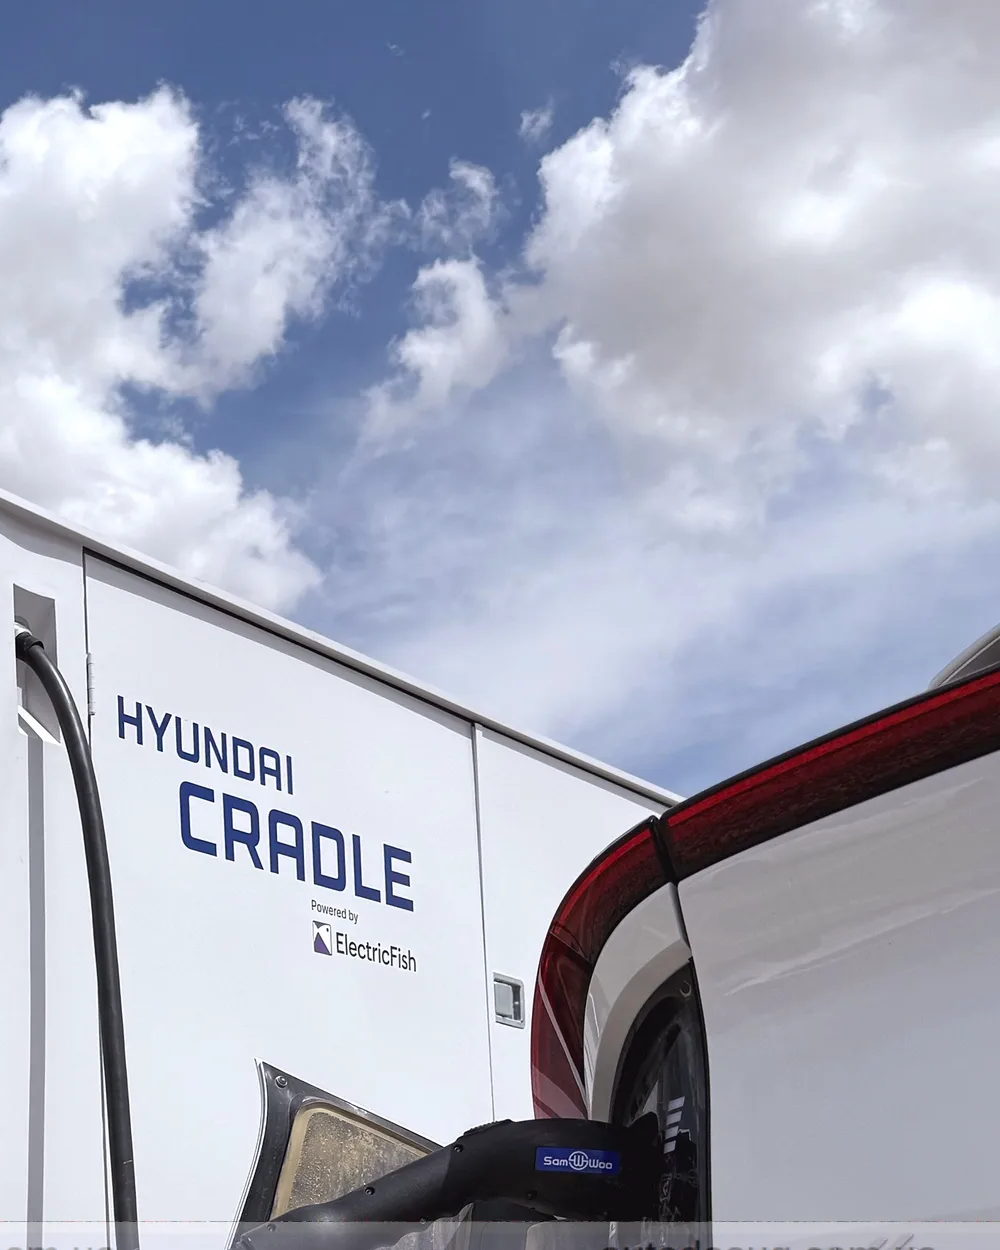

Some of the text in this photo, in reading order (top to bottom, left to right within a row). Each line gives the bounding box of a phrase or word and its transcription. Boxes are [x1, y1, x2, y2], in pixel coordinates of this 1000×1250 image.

[117, 695, 294, 795] HYUNDAI
[178, 780, 414, 912] CRADLE
[311, 899, 359, 925] Powered by
[335, 931, 417, 972] ElectricFish
[543, 1156, 568, 1166] Sam
